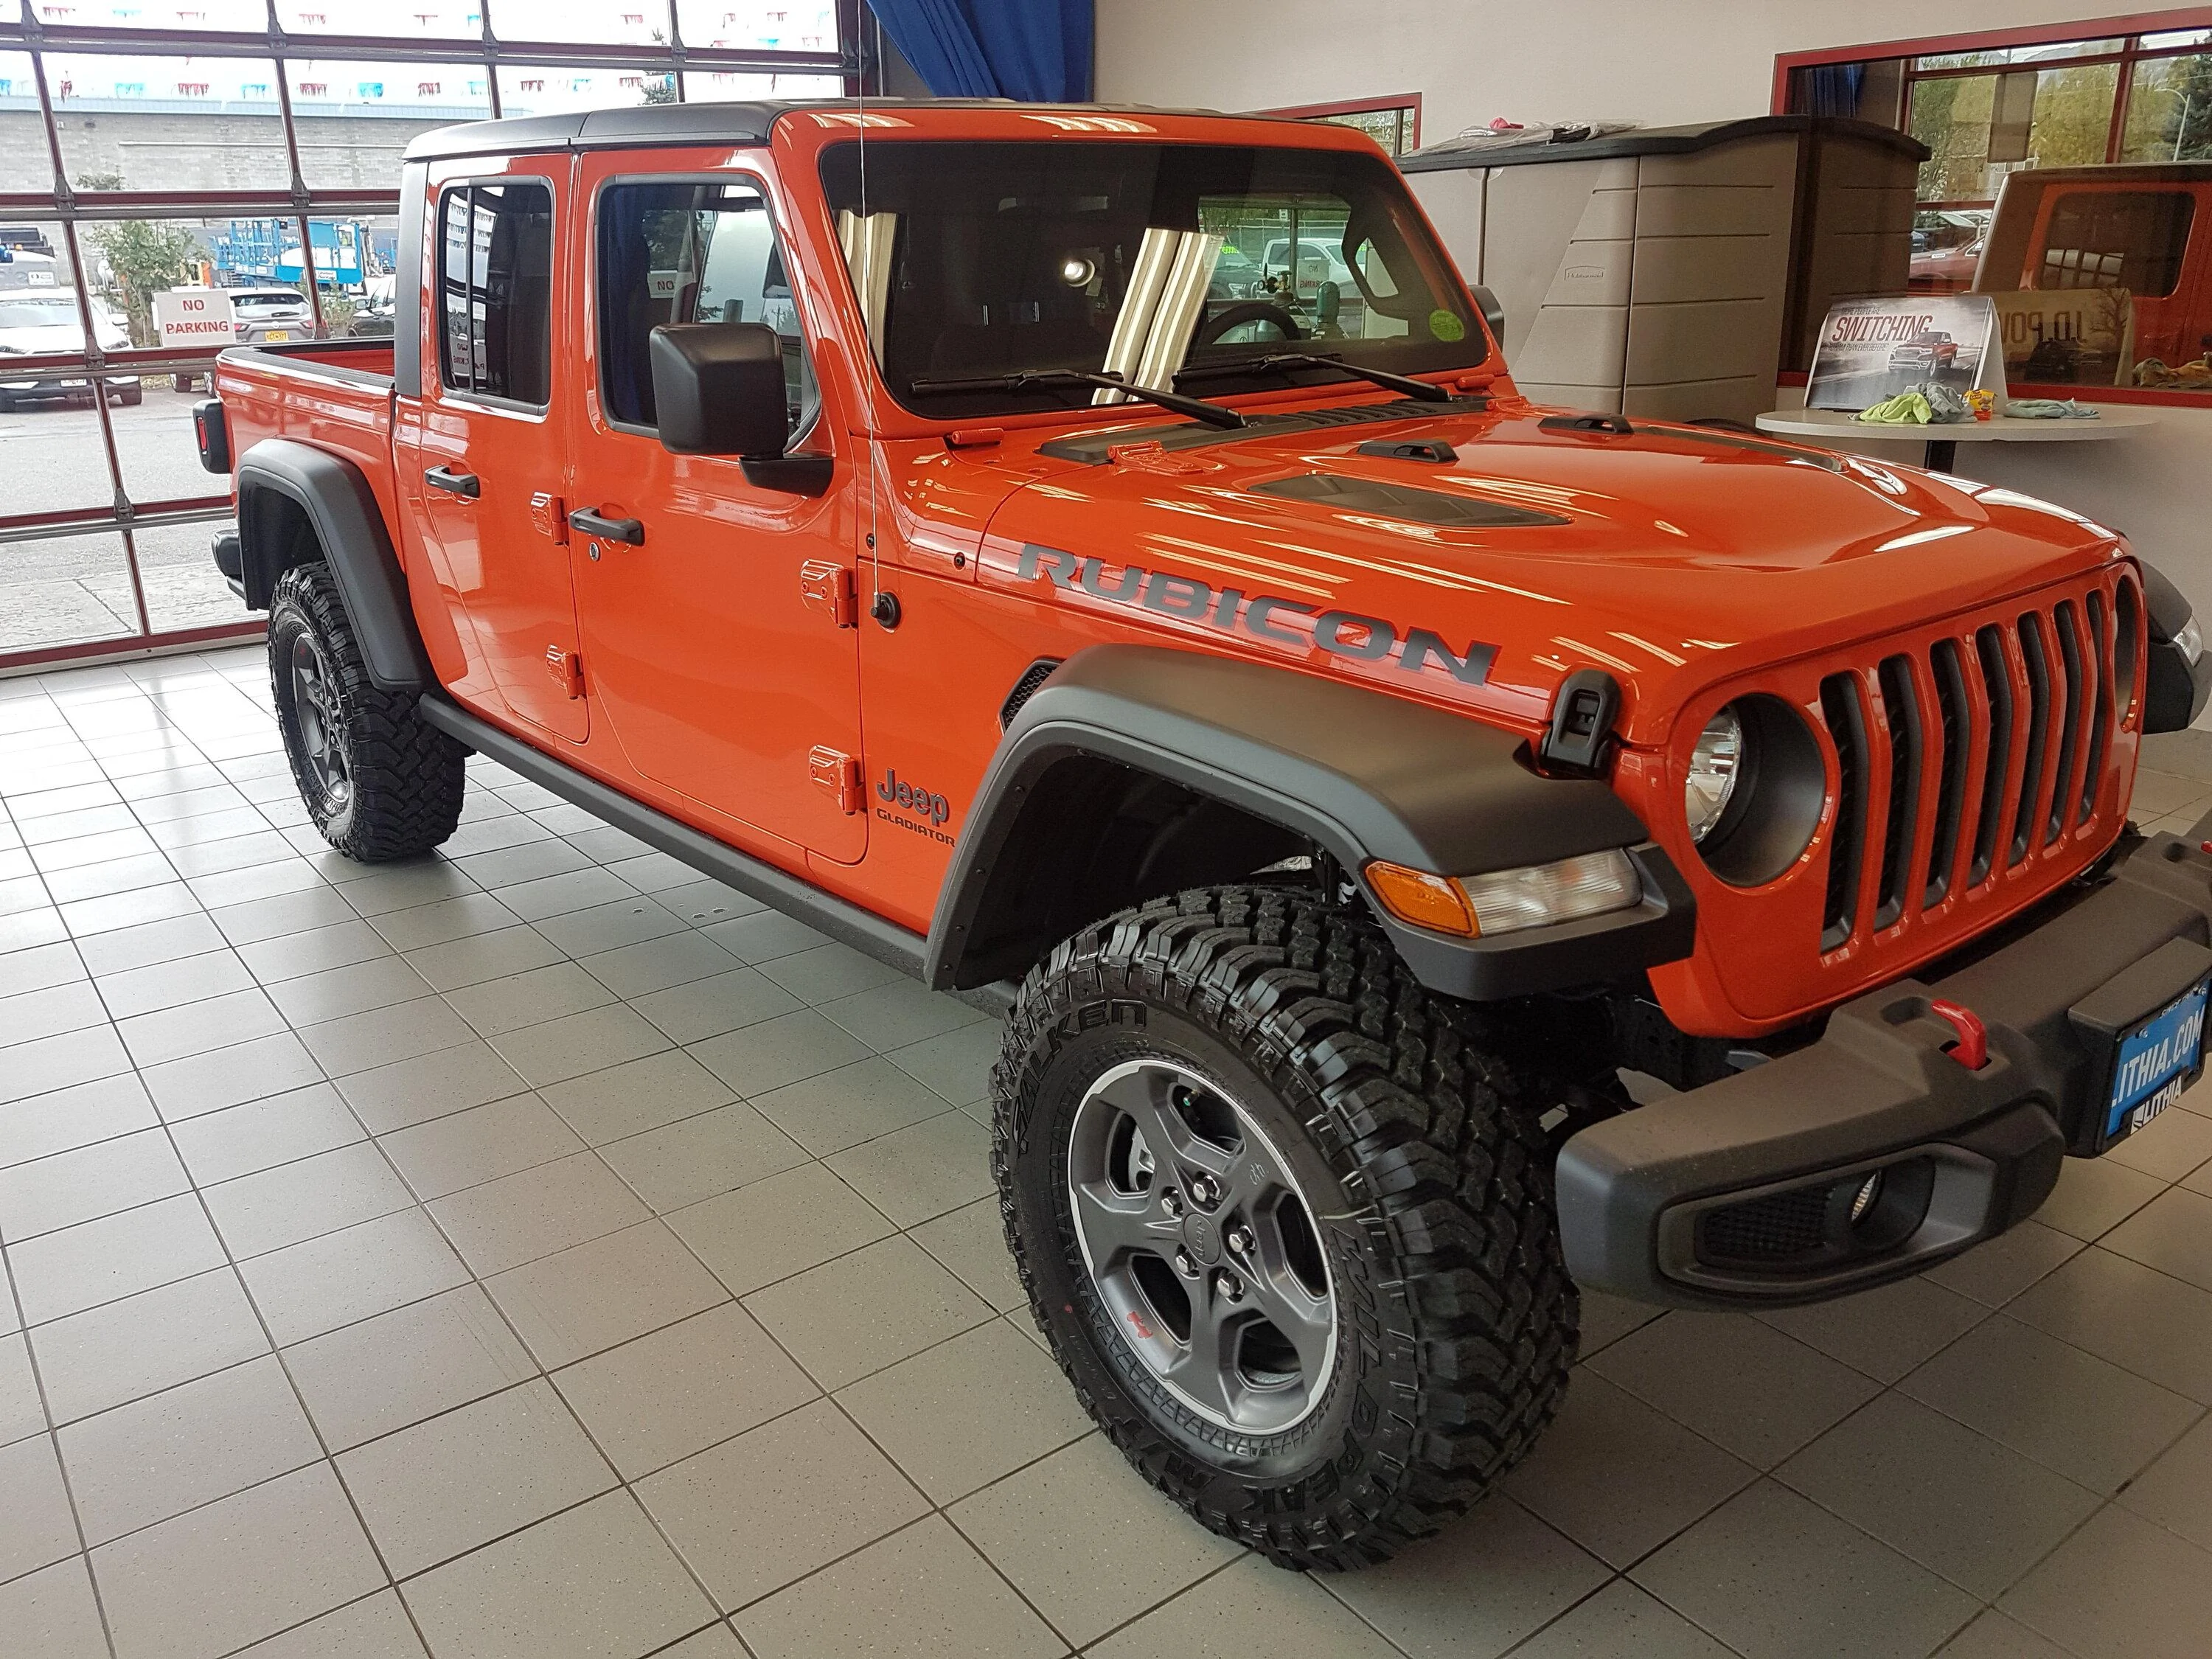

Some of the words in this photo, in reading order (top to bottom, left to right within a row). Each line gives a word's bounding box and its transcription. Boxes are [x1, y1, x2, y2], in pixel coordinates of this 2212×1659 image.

[657, 280, 675, 291] NO
[182, 299, 205, 311] NO
[165, 321, 229, 335] PARKING
[1832, 315, 1933, 341] SWITCHING
[1017, 543, 1500, 687] RUBICON
[877, 768, 950, 827] Jeep
[876, 807, 955, 847] GLADIATOR
[2143, 1075, 2182, 1125] LITHIA
